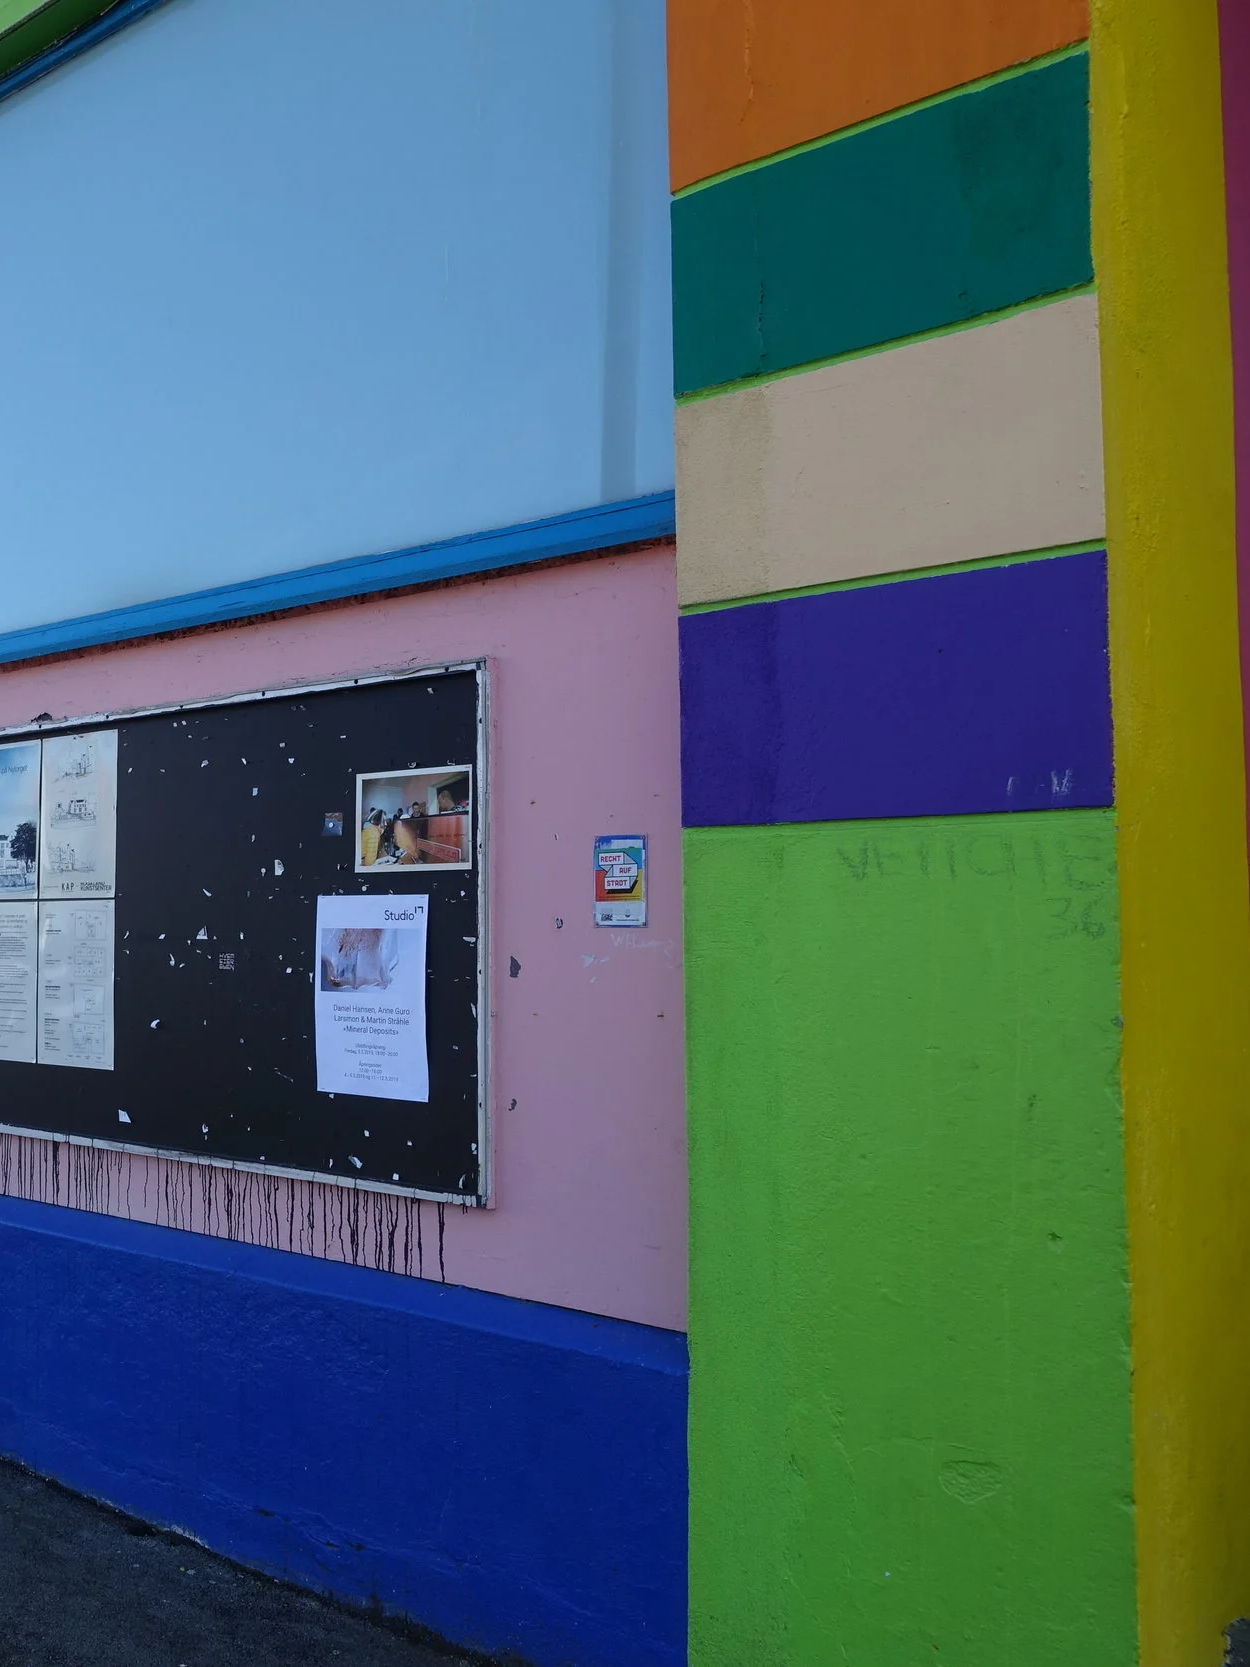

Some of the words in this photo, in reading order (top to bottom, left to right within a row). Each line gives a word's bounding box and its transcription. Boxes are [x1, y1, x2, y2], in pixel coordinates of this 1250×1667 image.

[61, 882, 75, 891] KAP
[333, 1004, 351, 1012] Daniel
[366, 1016, 387, 1024] Martin
